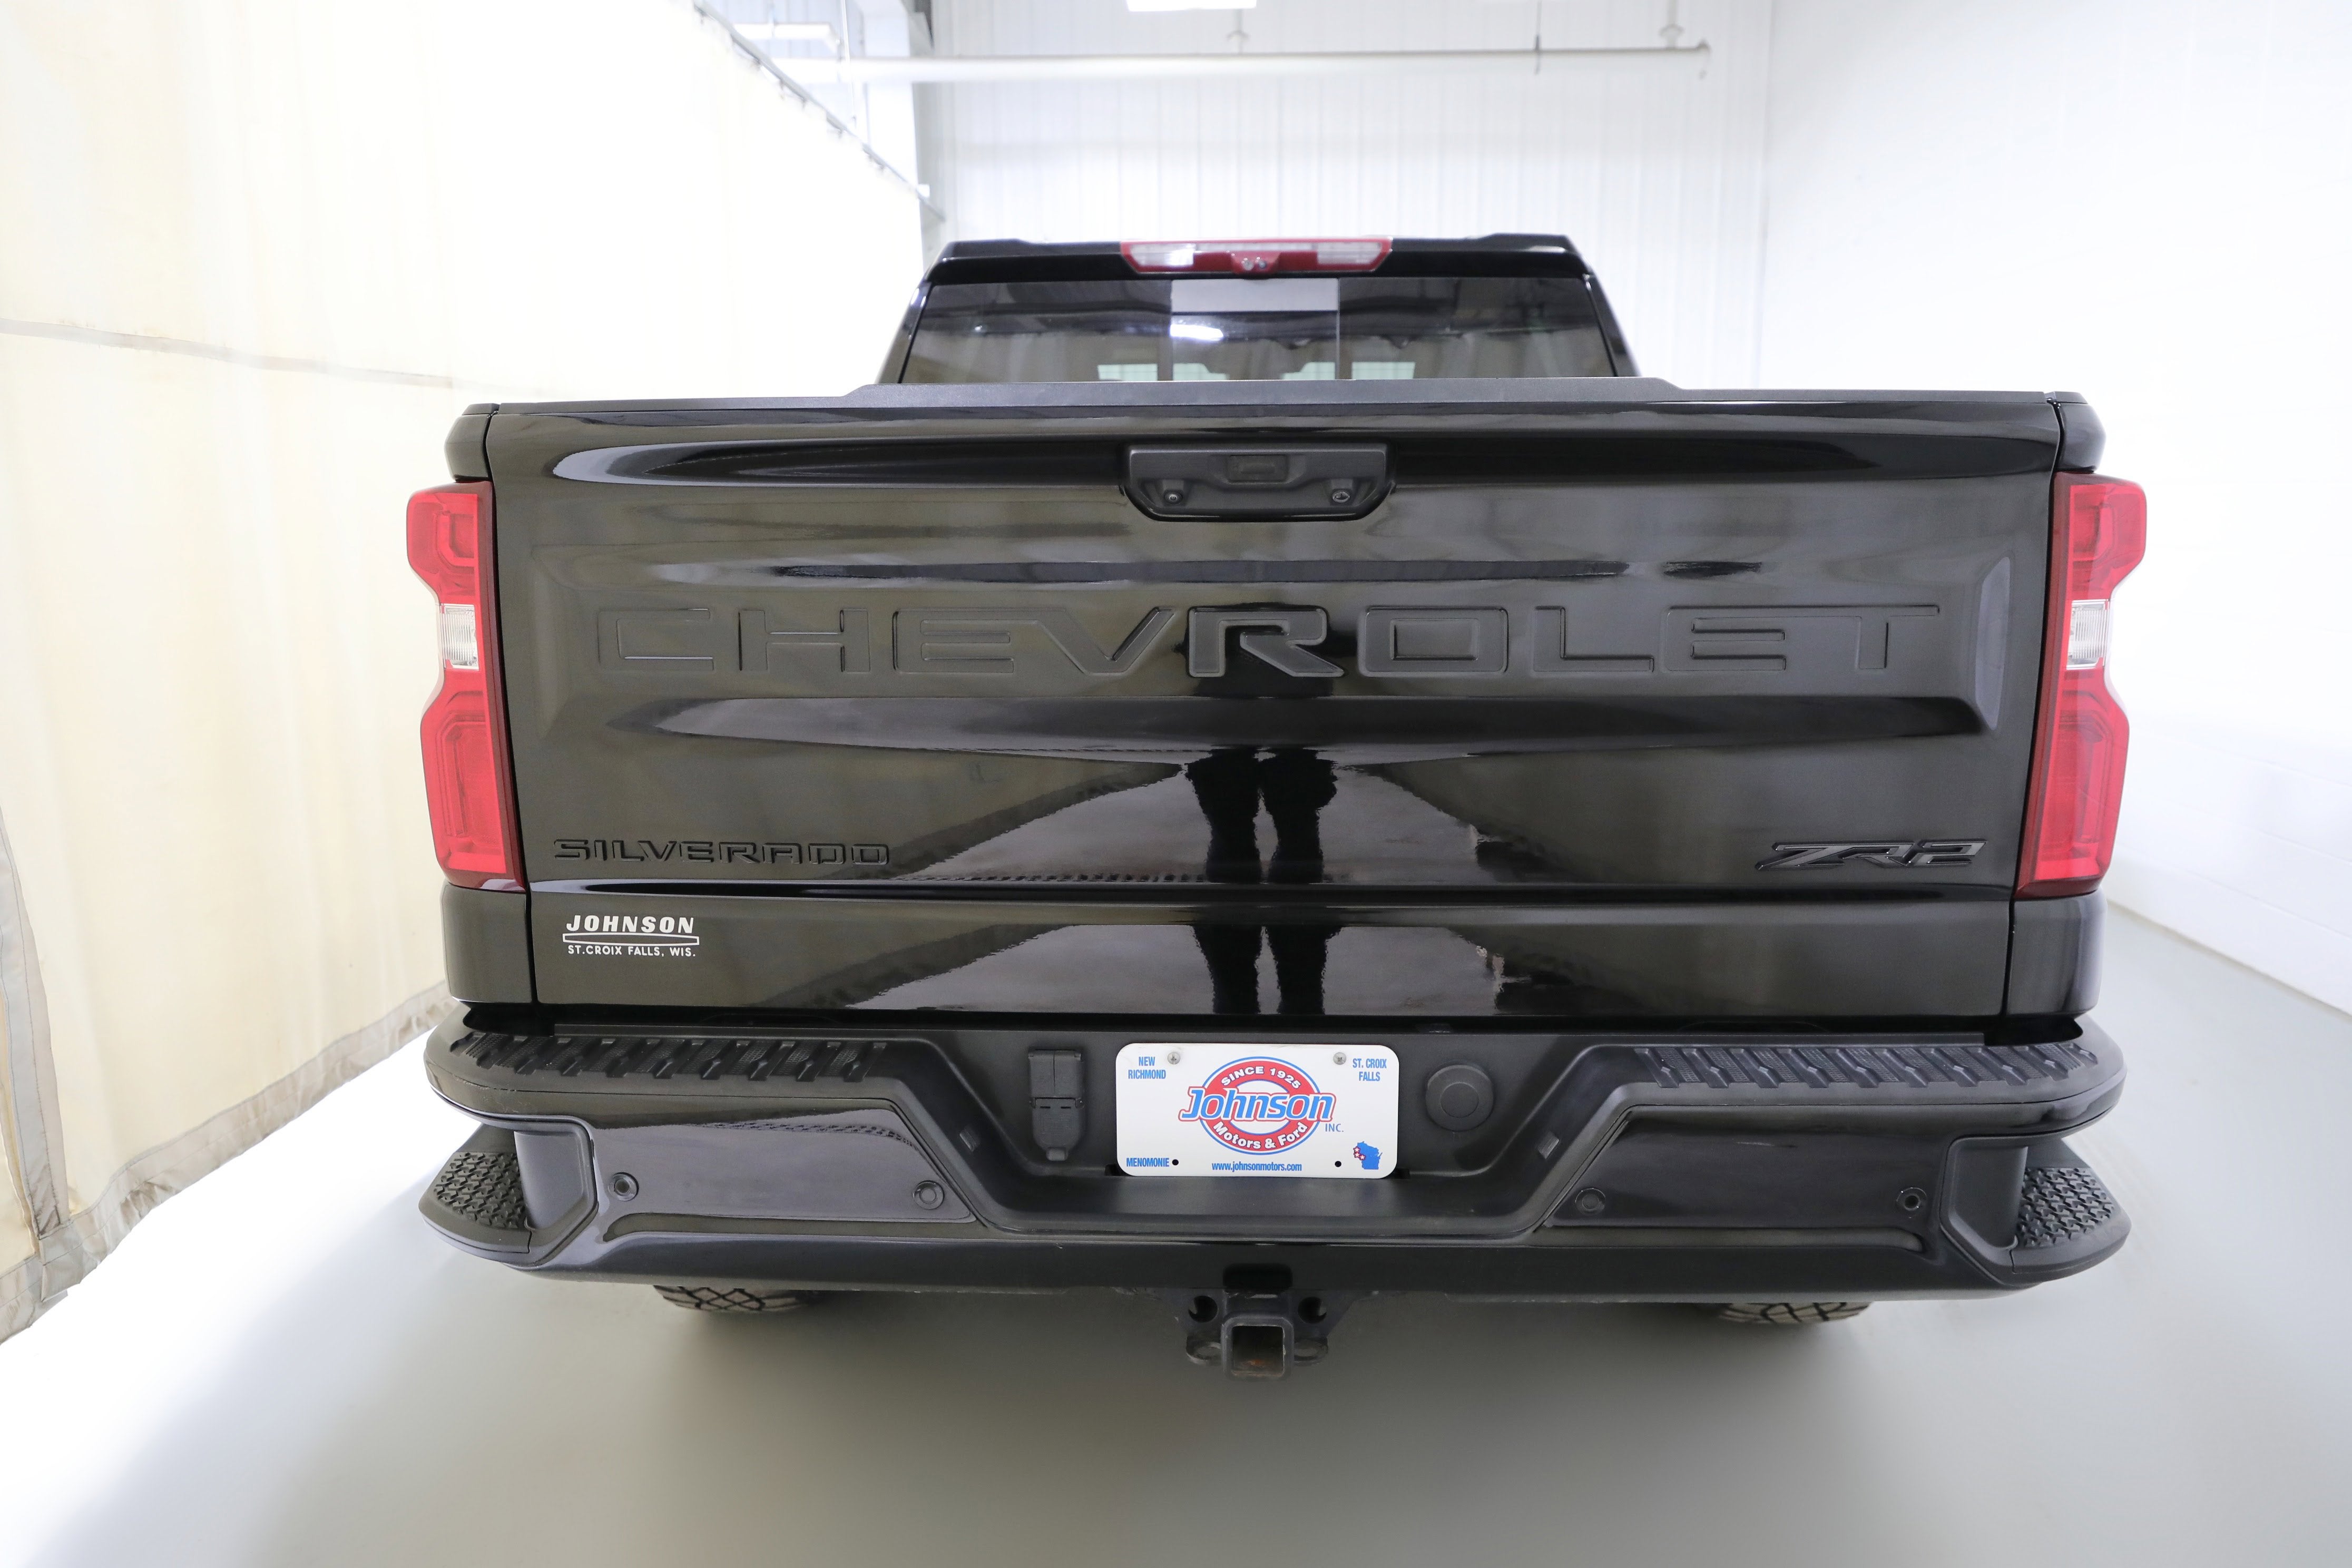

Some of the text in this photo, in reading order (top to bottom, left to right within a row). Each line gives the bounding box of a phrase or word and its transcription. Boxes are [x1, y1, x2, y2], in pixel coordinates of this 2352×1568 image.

[597, 605, 1940, 679] CHEVROLET
[554, 839, 890, 865] SILVERADO
[1755, 838, 1987, 870] ZR2
[565, 915, 694, 934] JOHNSON
[628, 946, 665, 957] FALLS,
[669, 947, 696, 957] WIS.
[1139, 1056, 1155, 1066] NEW
[1353, 1058, 1387, 1069] ST. CROIX
[1128, 1070, 1166, 1079] RICHMOND
[1221, 1066, 1301, 1090] SINCE 1925
[1359, 1071, 1380, 1081] FALLS
[1180, 1088, 1334, 1120] Johnson
[1325, 1123, 1344, 1132] INC.
[1213, 1121, 1309, 1150] Motors & Ford
[1126, 1158, 1170, 1167] MENOMONIE
[1212, 1161, 1302, 1173] www.johnsonmotors.com
